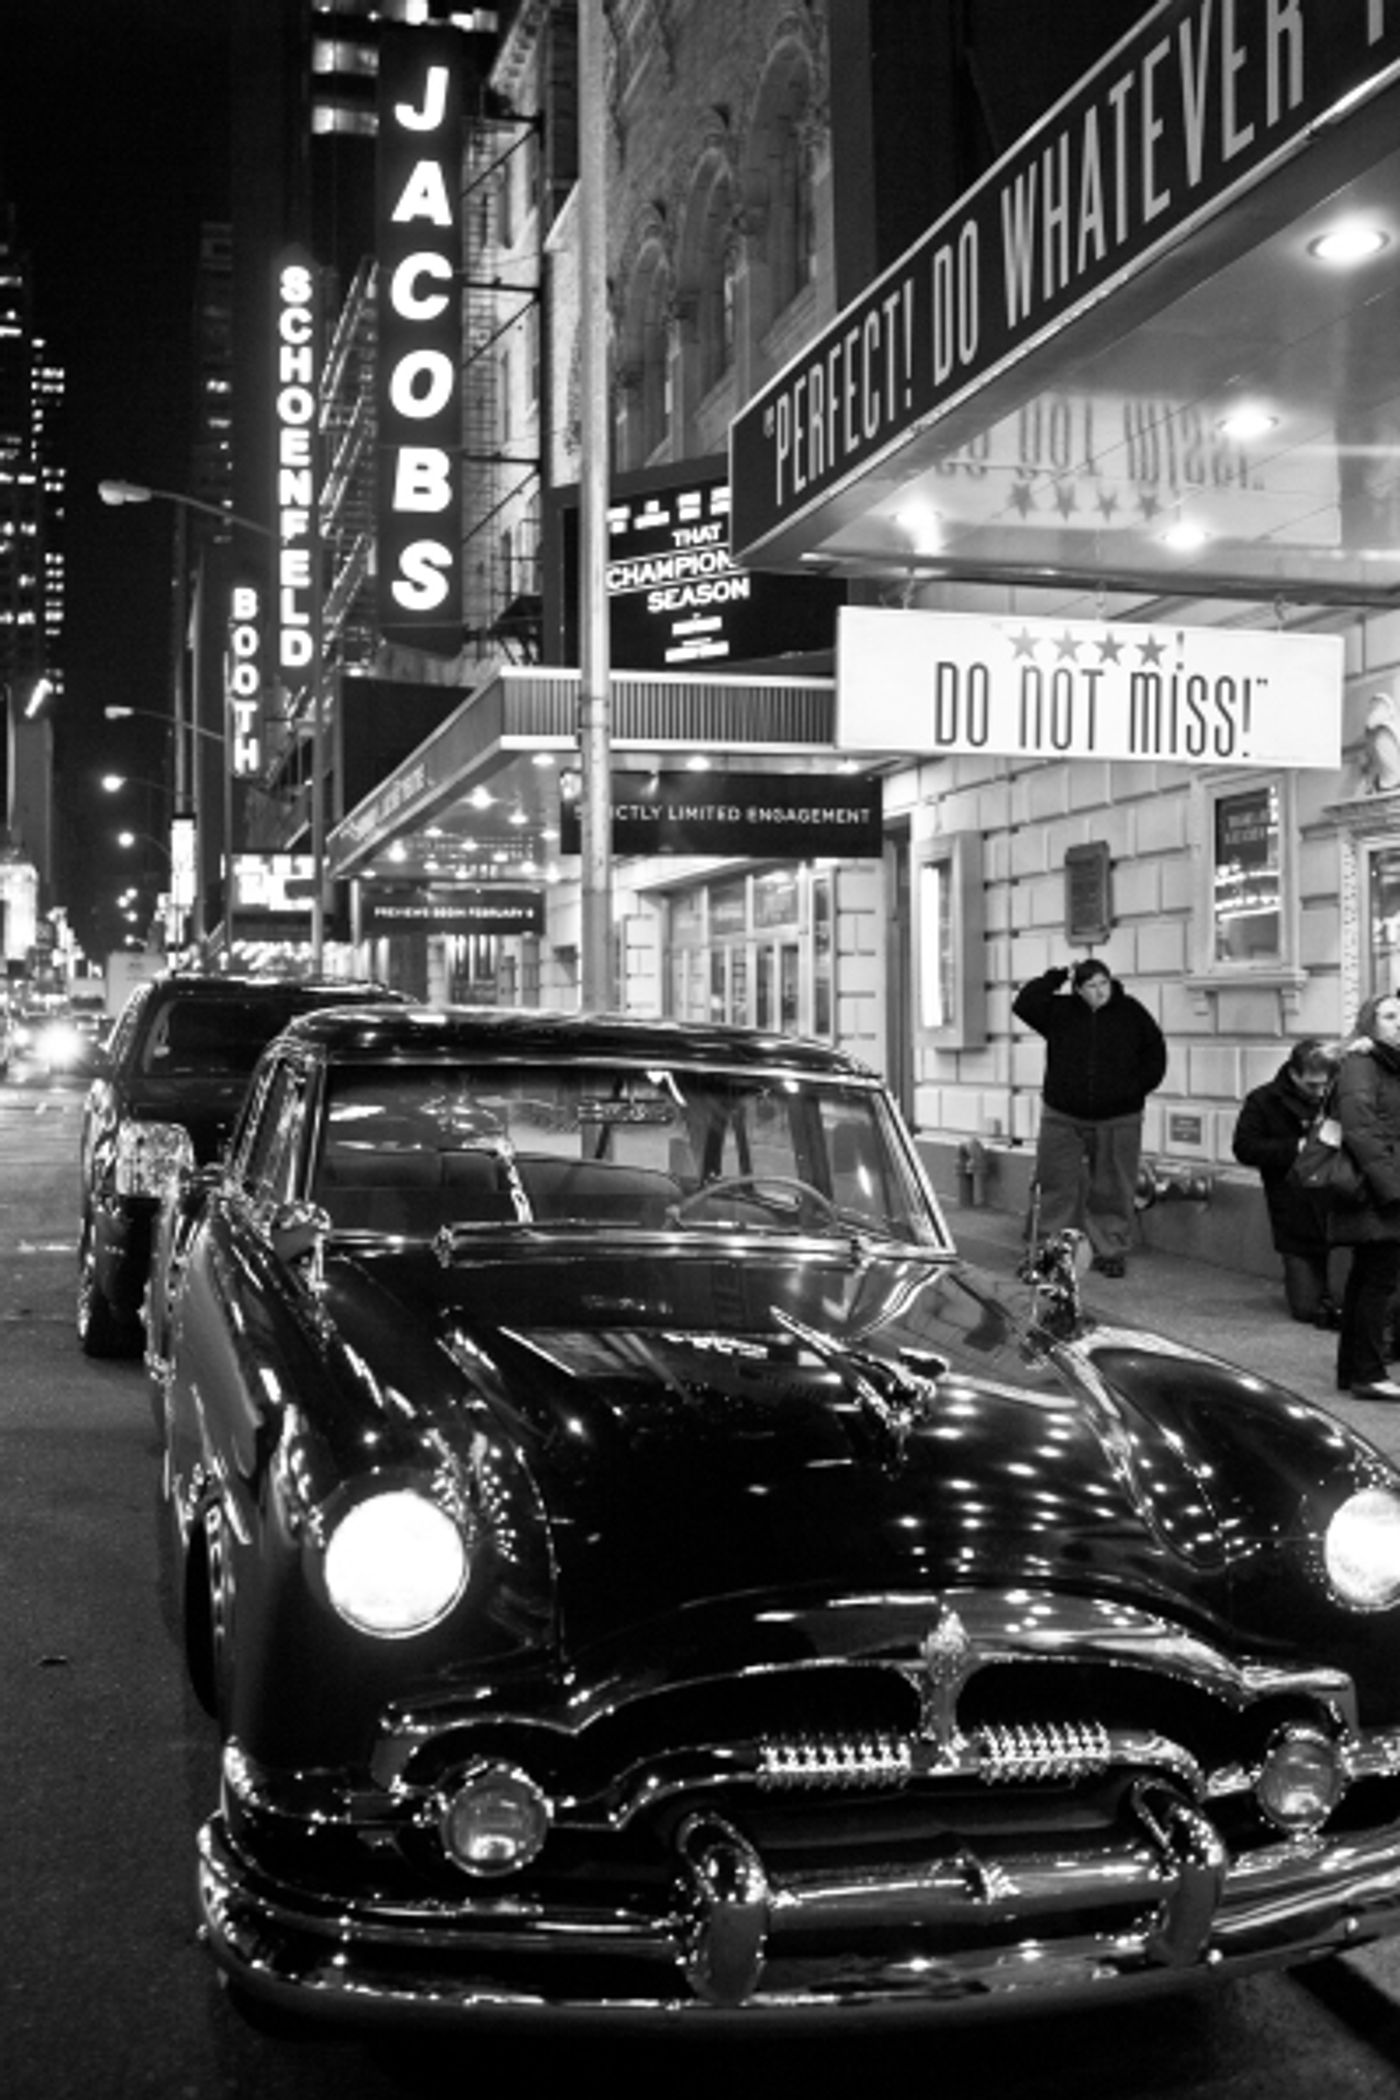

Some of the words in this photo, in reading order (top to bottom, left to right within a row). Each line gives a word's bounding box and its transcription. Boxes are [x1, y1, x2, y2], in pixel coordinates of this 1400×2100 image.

[932, 219, 979, 386] DO
[1001, 0, 1304, 330] WHATEVER
[390, 65, 454, 612] JACOBS
[276, 265, 314, 667] SCHOENFELD
[671, 523, 723, 547] THAT
[647, 577, 750, 613] SEASON
[231, 587, 260, 775] BOOTH
[934, 660, 990, 748] DO
[667, 805, 741, 821] LIMITED
[746, 806, 870, 824] ENGAGEMENT
